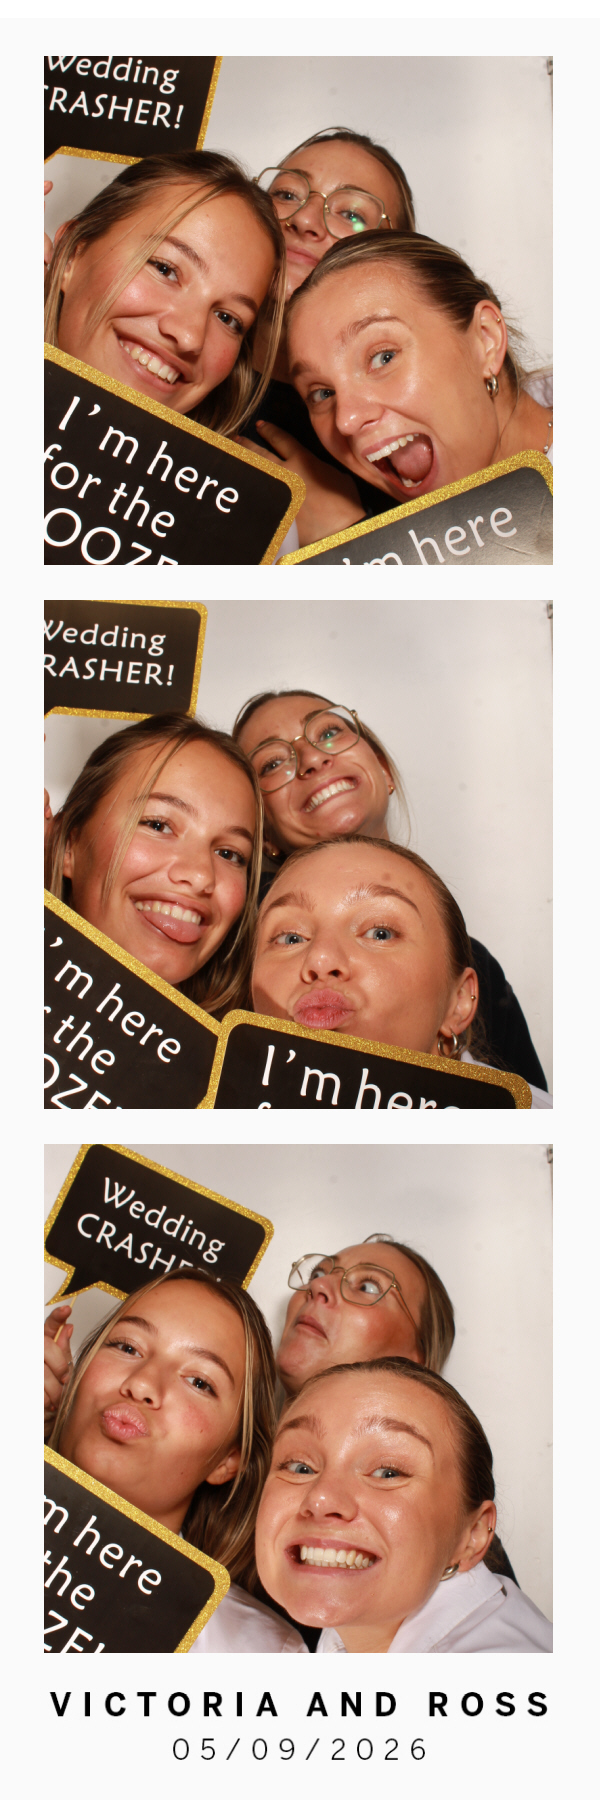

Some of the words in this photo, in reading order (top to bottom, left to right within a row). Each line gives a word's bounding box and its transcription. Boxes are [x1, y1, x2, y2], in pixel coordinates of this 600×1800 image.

[44, 84, 184, 129] RASHER!
[47, 56, 180, 94] Wedding
[58, 395, 139, 464] I’m
[146, 440, 239, 513] here
[108, 482, 175, 538] the
[408, 507, 517, 565] here
[53, 1015, 116, 1075] the
[96, 982, 181, 1063] here
[262, 1044, 341, 1106] I’m
[355, 1067, 461, 1109] her
[77, 1213, 222, 1283] CRASH
[103, 1176, 226, 1264] Wedding
[73, 1515, 162, 1595] here
